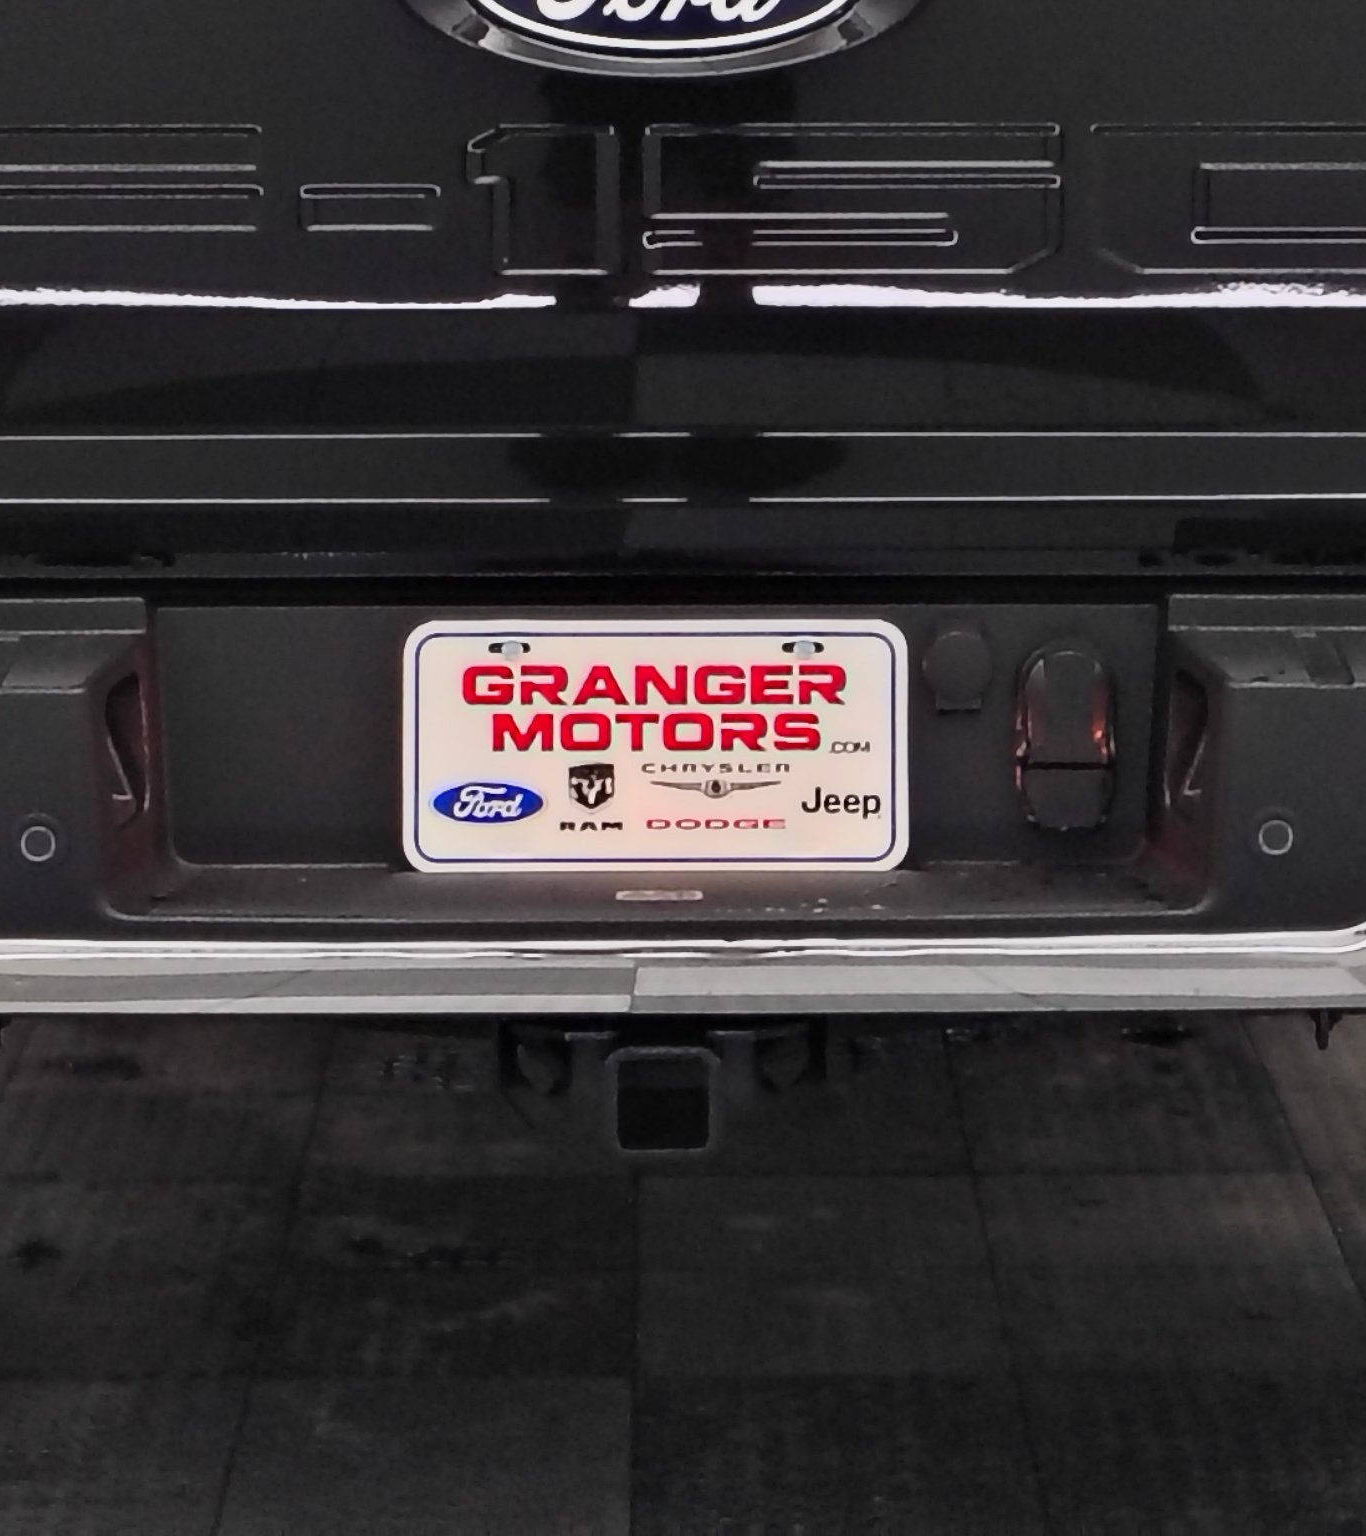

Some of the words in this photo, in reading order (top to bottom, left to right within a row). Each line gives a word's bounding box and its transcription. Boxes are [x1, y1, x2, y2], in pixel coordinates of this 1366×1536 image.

[463, 665, 847, 706] GRANGER
[492, 713, 822, 752] MOTORS
[641, 763, 790, 774] CHRYSLER
[453, 785, 523, 818] Ford
[801, 786, 882, 819] Jeep
[560, 821, 624, 832] RAM
[647, 818, 787, 831] DODGE
